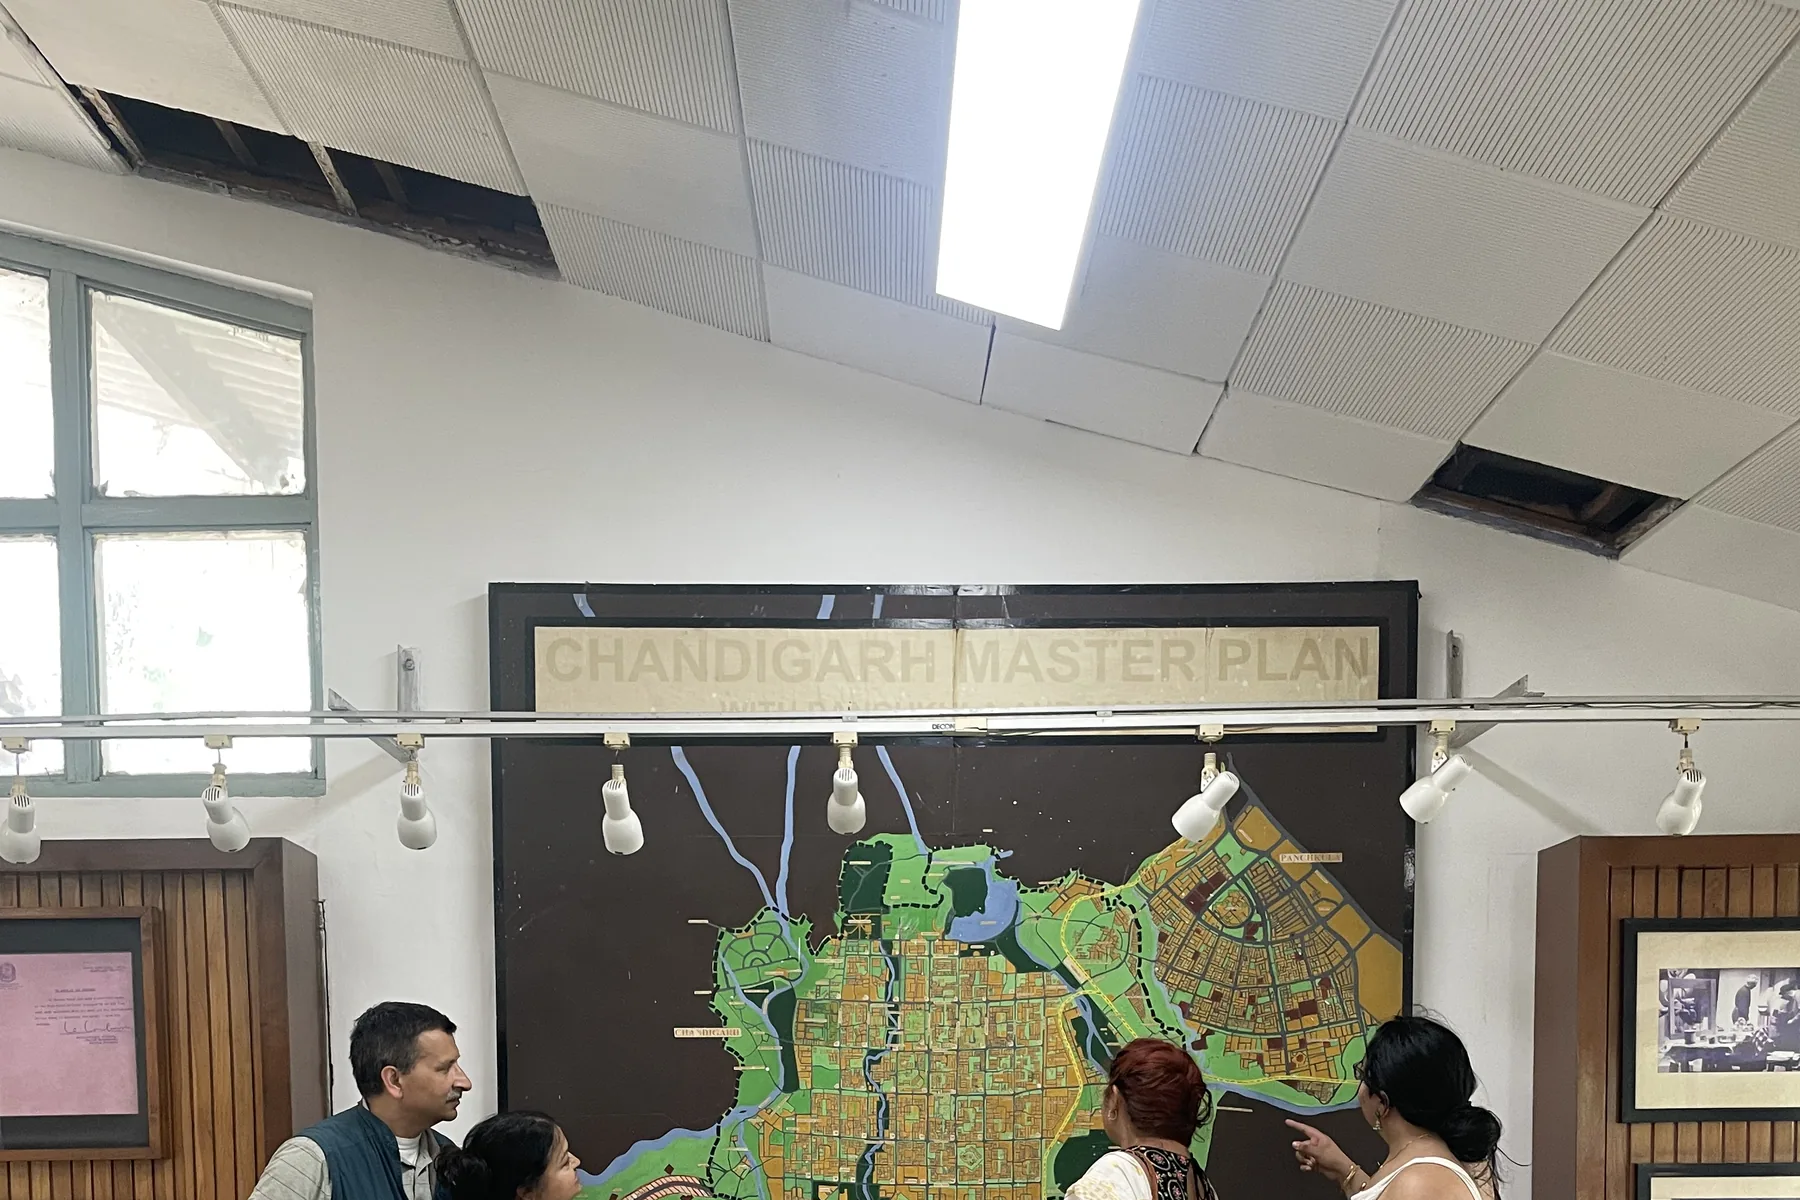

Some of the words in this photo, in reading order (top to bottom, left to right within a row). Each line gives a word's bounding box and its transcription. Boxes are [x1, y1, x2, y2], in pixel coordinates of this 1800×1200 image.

[545, 637, 935, 683] CHANDIGARH
[961, 638, 1197, 683] MASTER
[1219, 637, 1368, 682] PLAN
